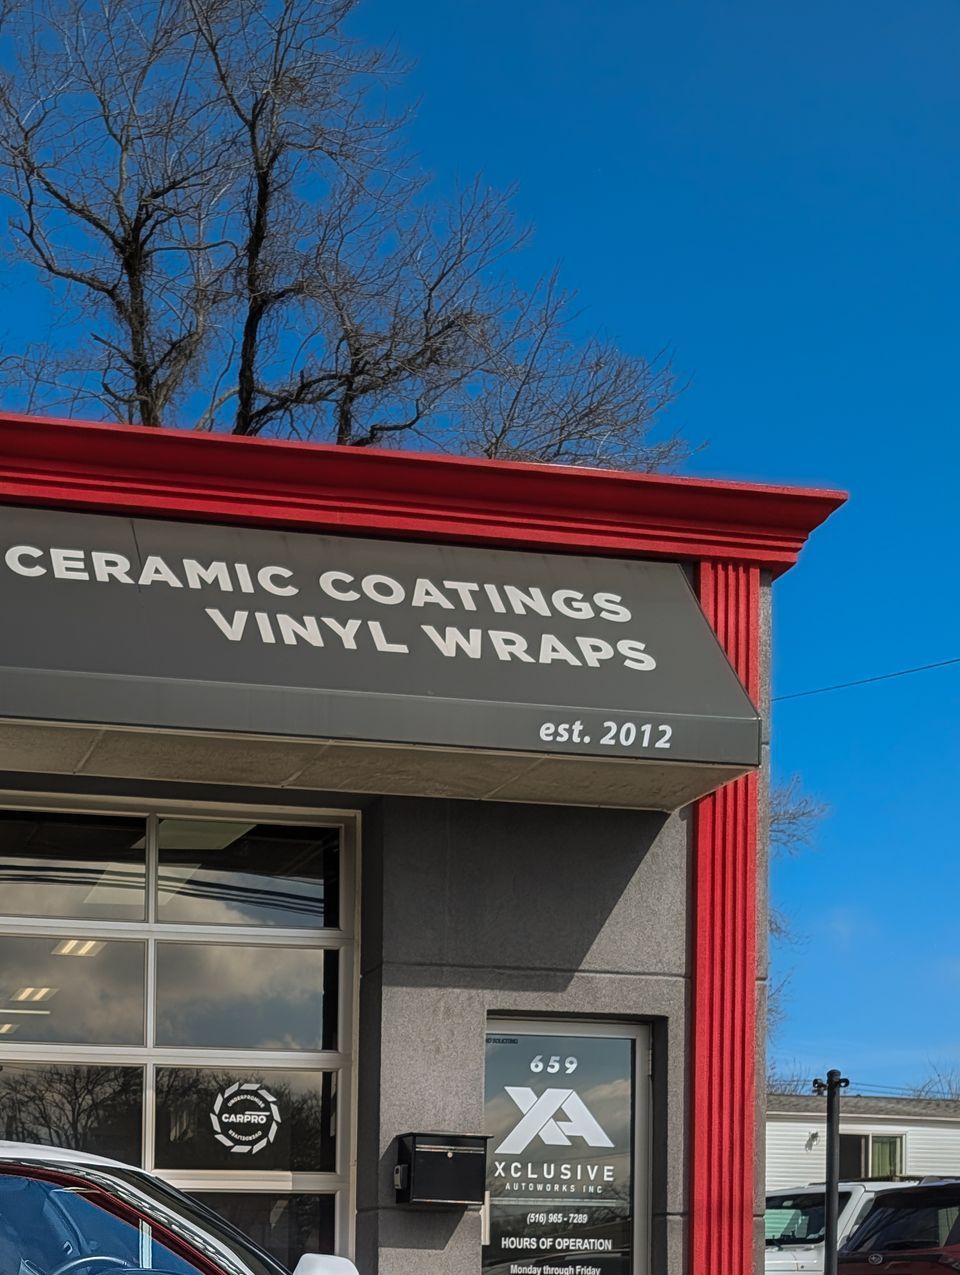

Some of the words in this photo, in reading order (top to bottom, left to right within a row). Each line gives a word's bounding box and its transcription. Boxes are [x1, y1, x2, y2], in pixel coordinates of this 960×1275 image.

[4, 545, 299, 598] CERAMIC
[318, 570, 633, 624] COATINGS
[204, 607, 410, 656] VINYL
[420, 624, 658, 672] WRAPS
[538, 718, 591, 745] est.
[599, 721, 673, 750] 2012
[530, 1055, 578, 1074] 659
[221, 1113, 267, 1124] CARPRO
[494, 1161, 614, 1182] XCLUSIVE
[505, 1182, 576, 1193] AUTOWORKS
[583, 1185, 603, 1194] INC
[526, 1212, 547, 1225] (516)
[548, 1213, 563, 1223] 965
[568, 1213, 588, 1224] 7289
[501, 1237, 538, 1249] HOURS
[539, 1238, 554, 1249] OF
[555, 1239, 612, 1250] OPERATION
[510, 1264, 542, 1275] Monday
